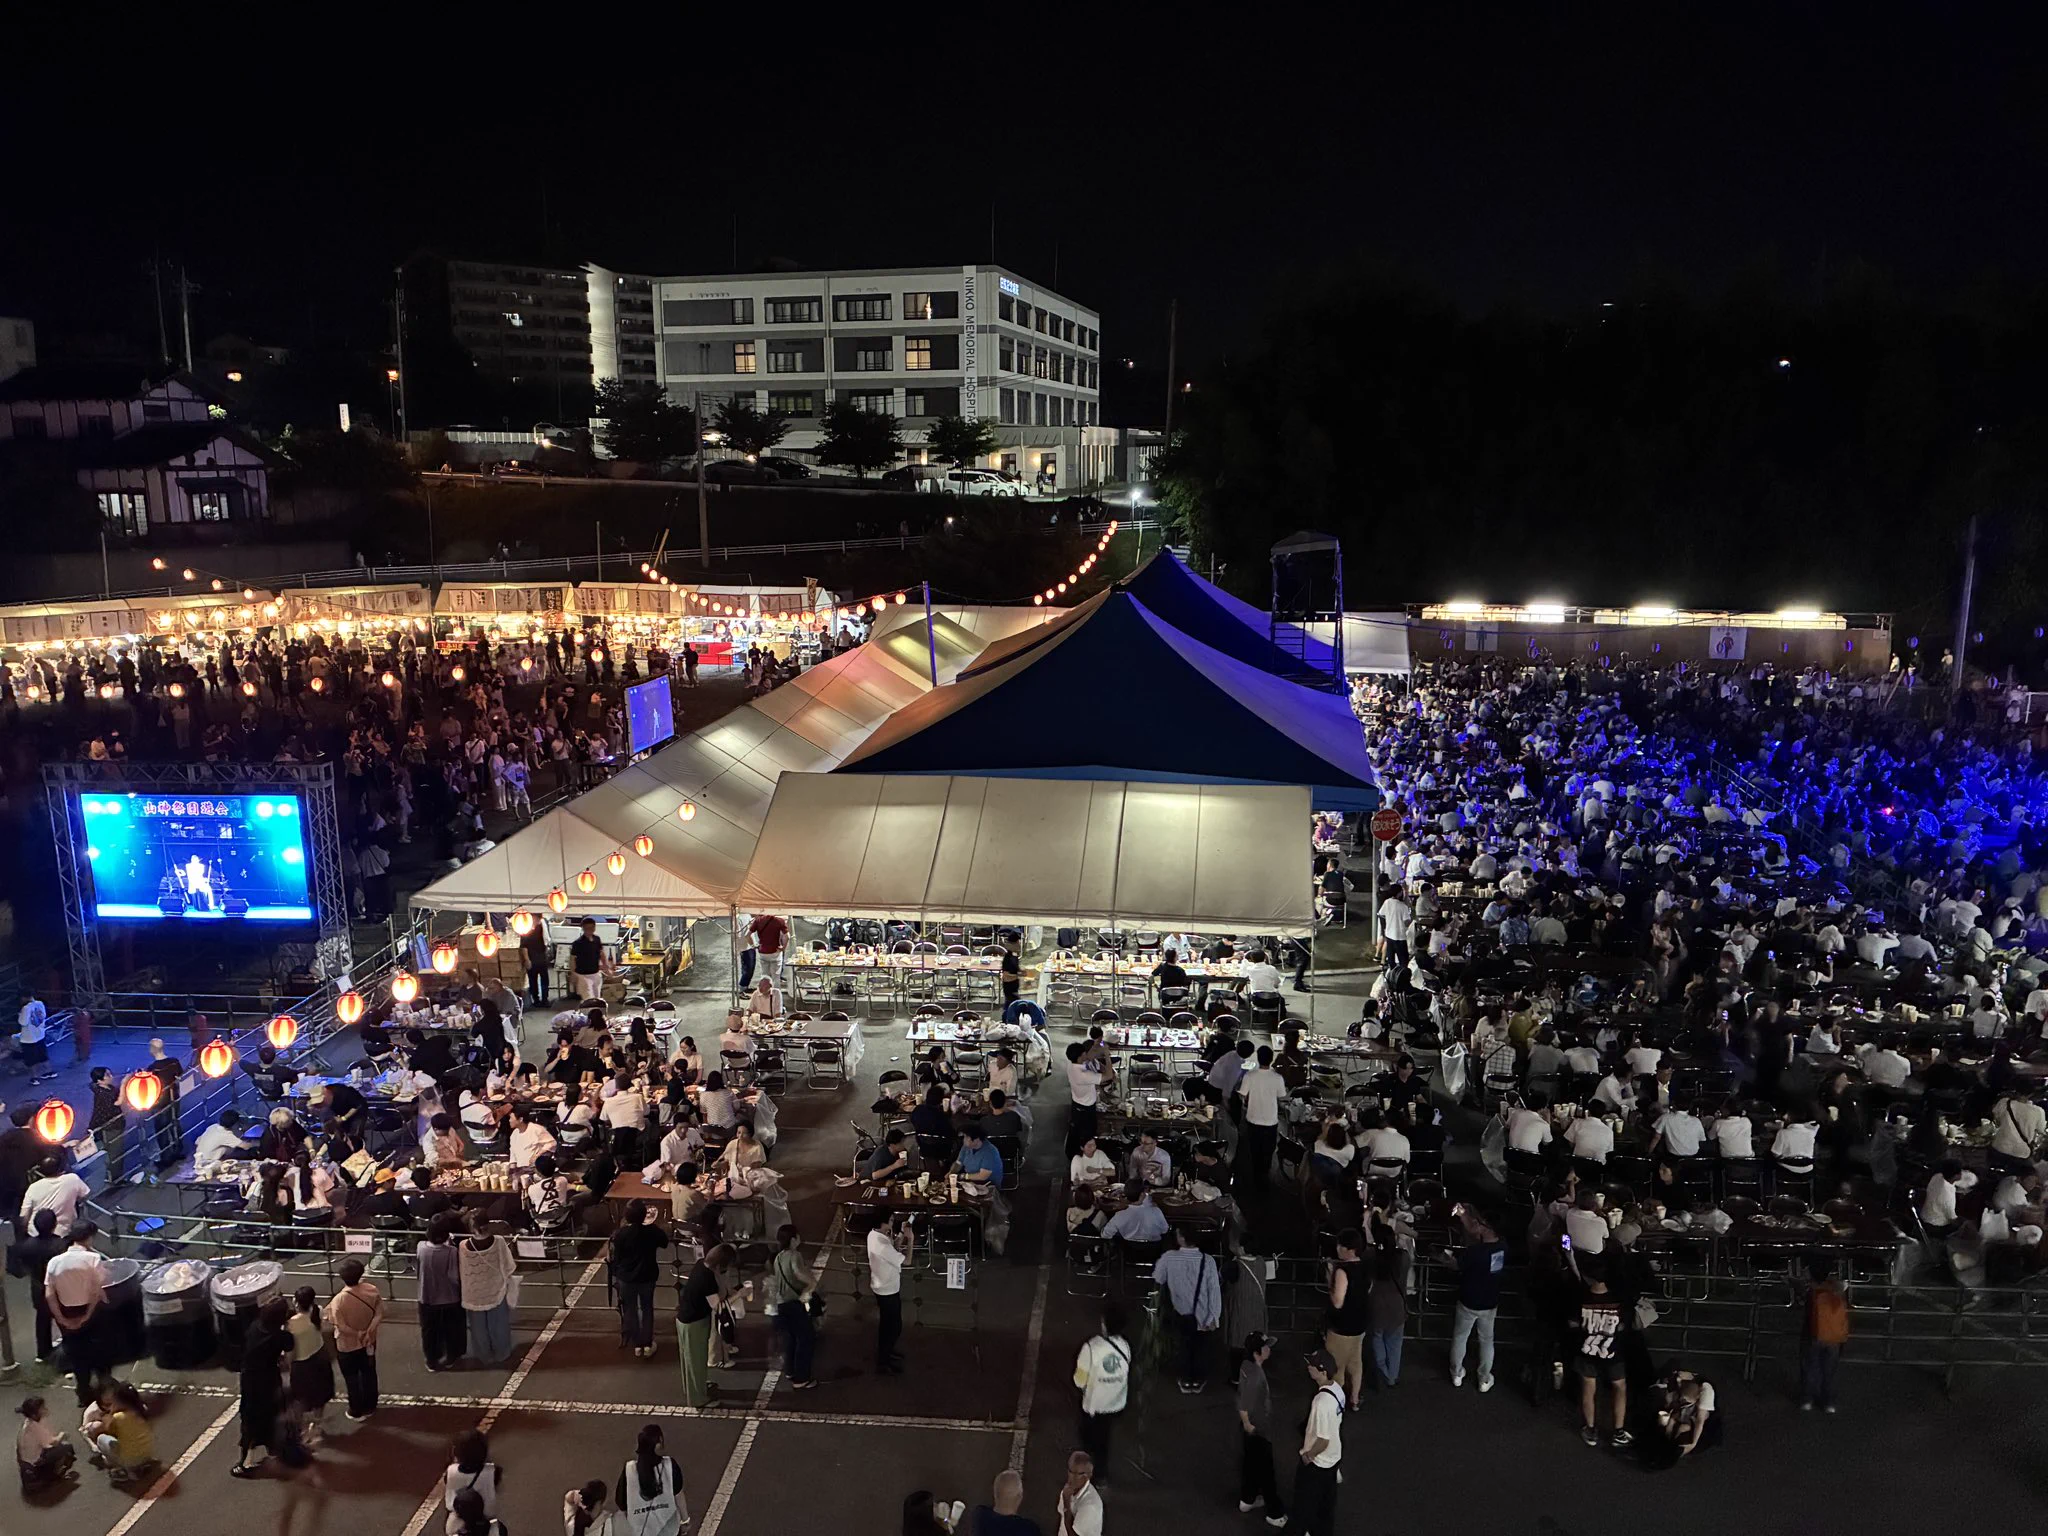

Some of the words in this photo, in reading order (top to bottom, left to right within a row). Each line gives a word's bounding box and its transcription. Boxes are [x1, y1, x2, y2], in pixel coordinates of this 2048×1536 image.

[965, 276, 975, 310] NIKKO
[965, 315, 975, 372] MEMORIAL
[966, 376, 976, 423] HOSPITA
[143, 800, 229, 816] 山神祭園遊会
